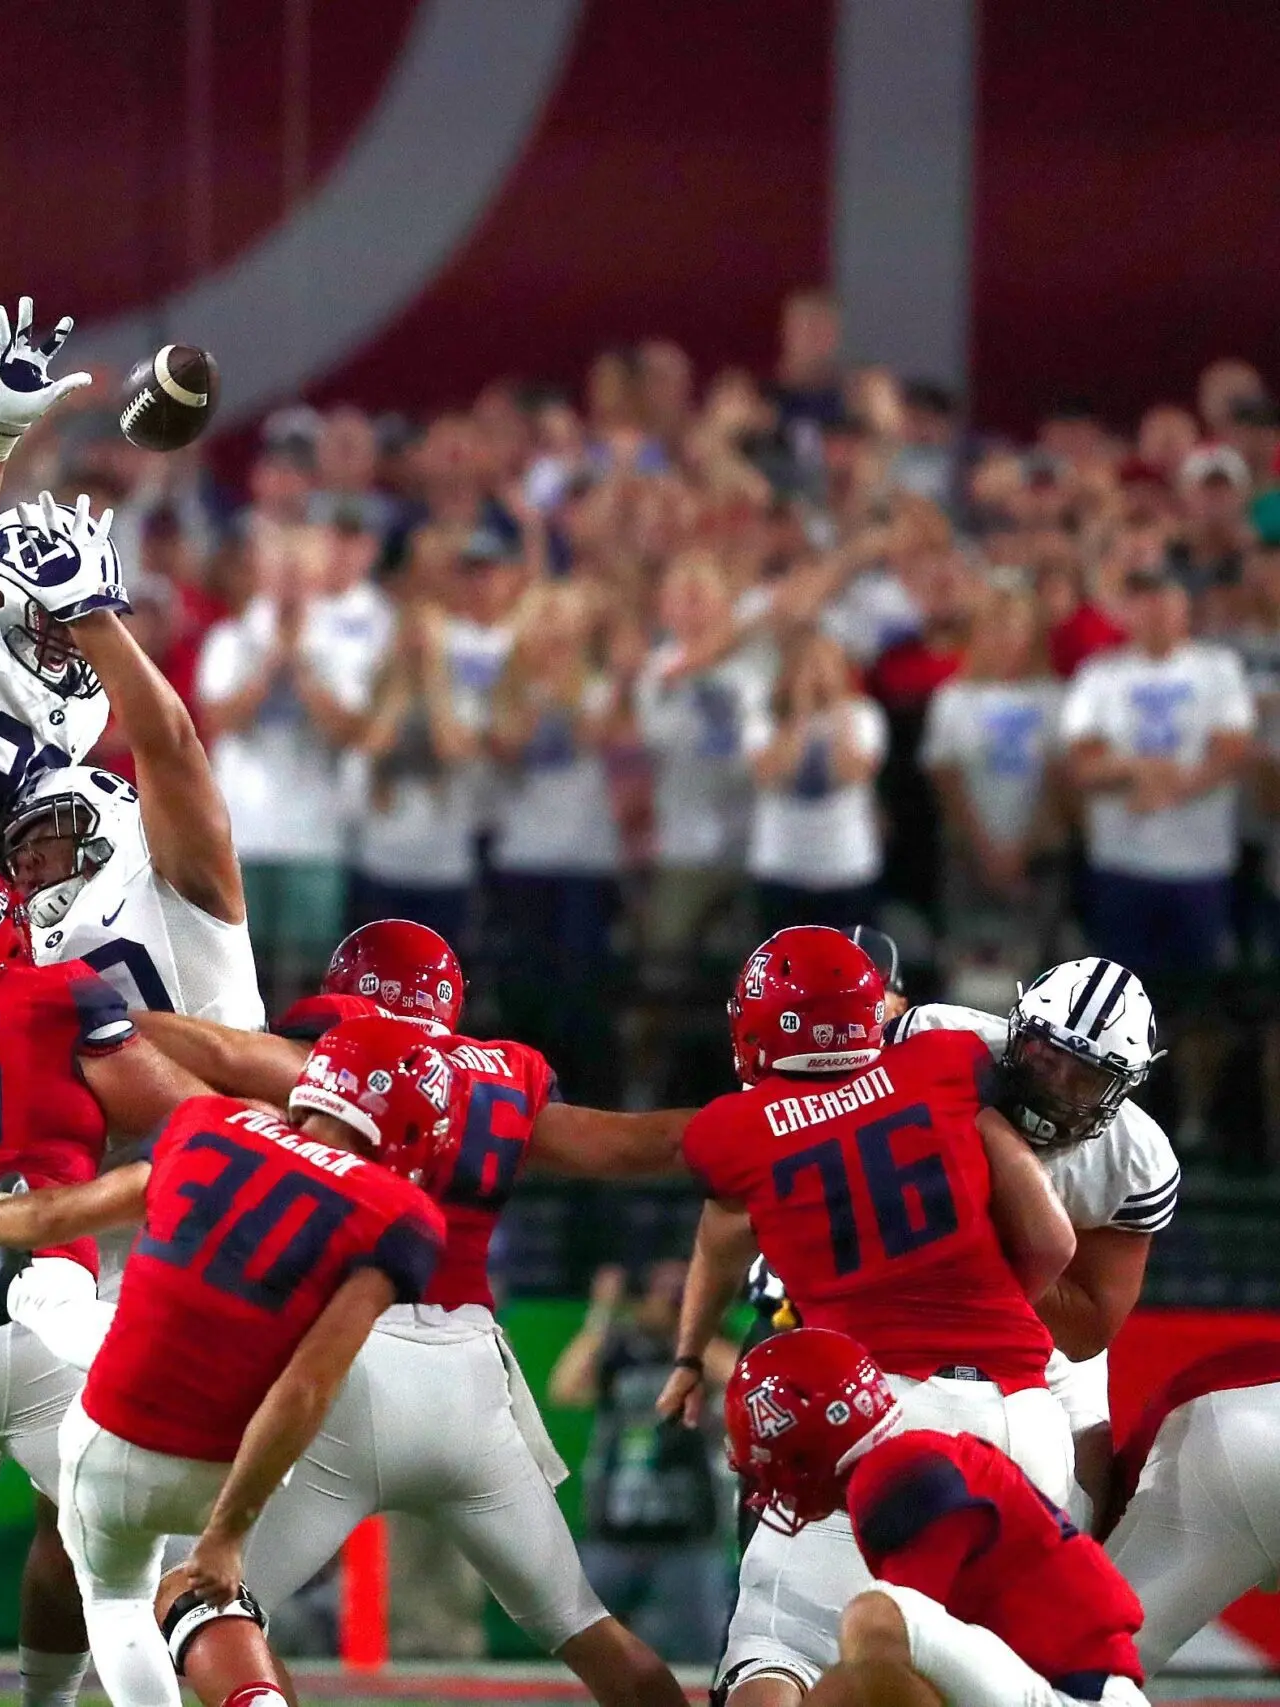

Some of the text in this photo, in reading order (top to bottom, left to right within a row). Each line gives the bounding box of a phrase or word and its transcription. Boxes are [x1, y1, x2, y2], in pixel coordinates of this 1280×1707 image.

[439, 983, 451, 1000] 65
[745, 952, 772, 999] A
[368, 1072, 391, 1093] 65
[807, 1055, 870, 1068] BEARDOWN
[764, 1066, 895, 1136] CREASON
[441, 1081, 528, 1208] 6
[773, 1103, 958, 1277] 76
[136, 1131, 357, 1314] 30
[746, 1386, 797, 1438] A
